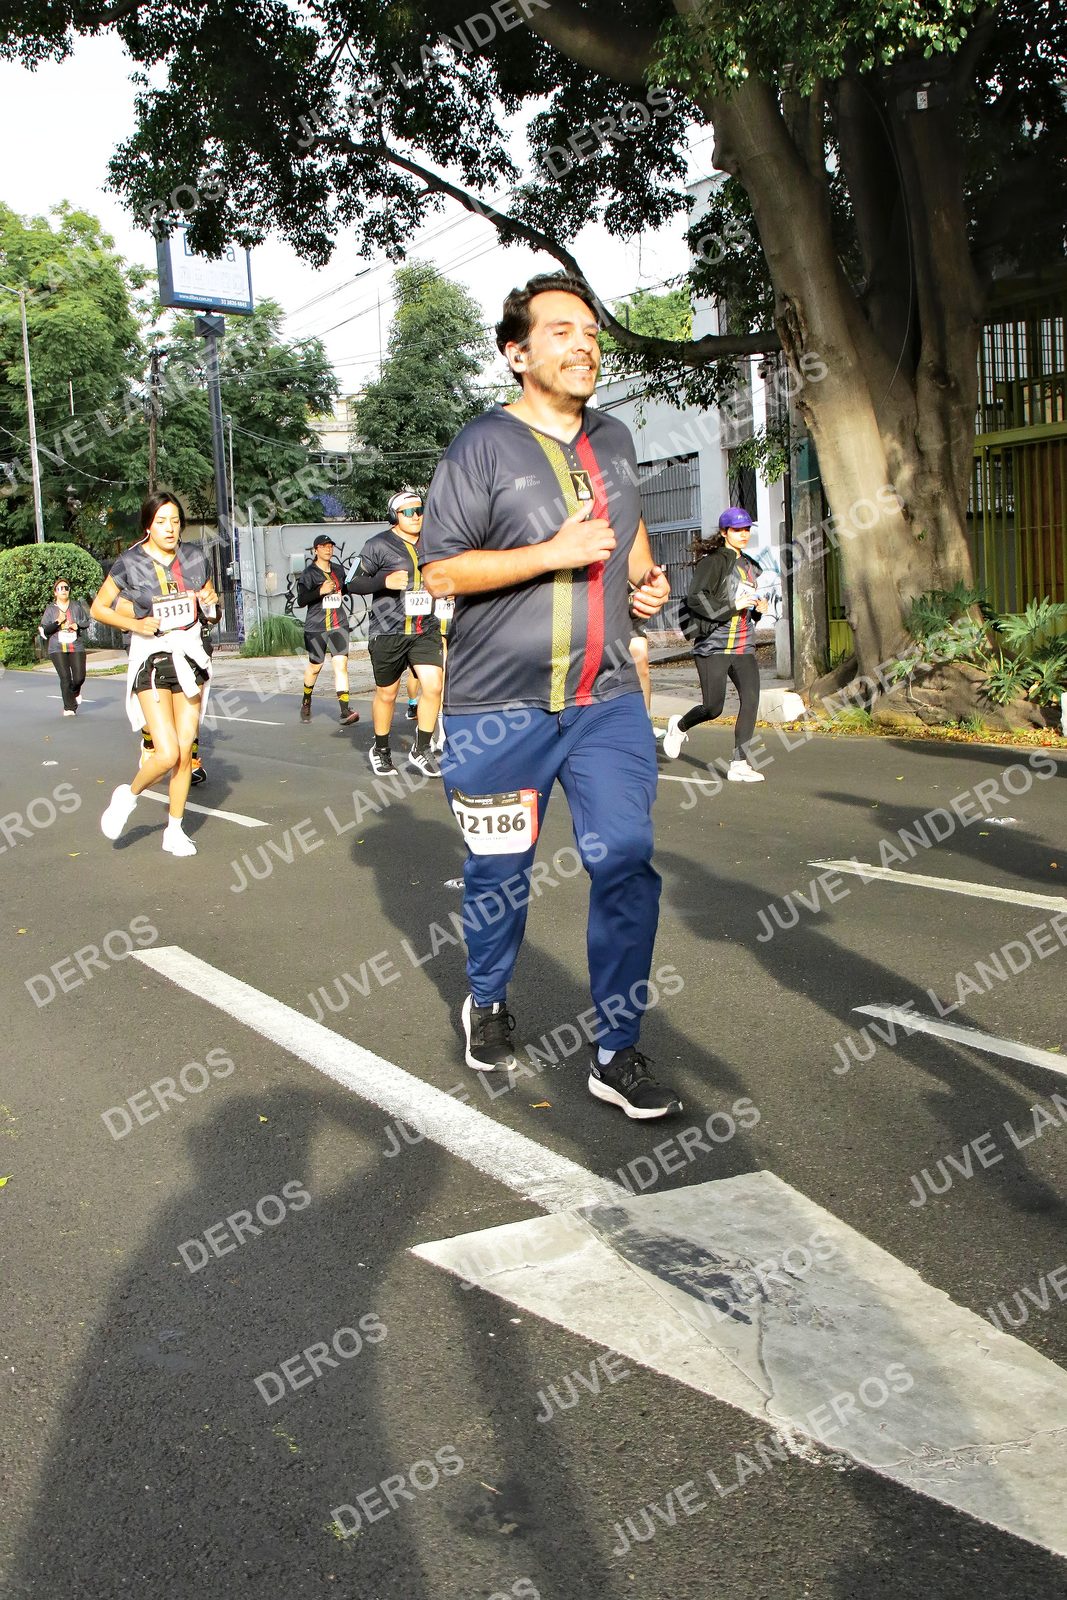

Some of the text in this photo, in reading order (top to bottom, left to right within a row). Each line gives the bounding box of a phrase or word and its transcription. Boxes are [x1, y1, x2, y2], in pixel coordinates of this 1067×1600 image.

[410, 597, 429, 606] 9224
[156, 602, 190, 618] 13131
[457, 811, 526, 834] 12186
